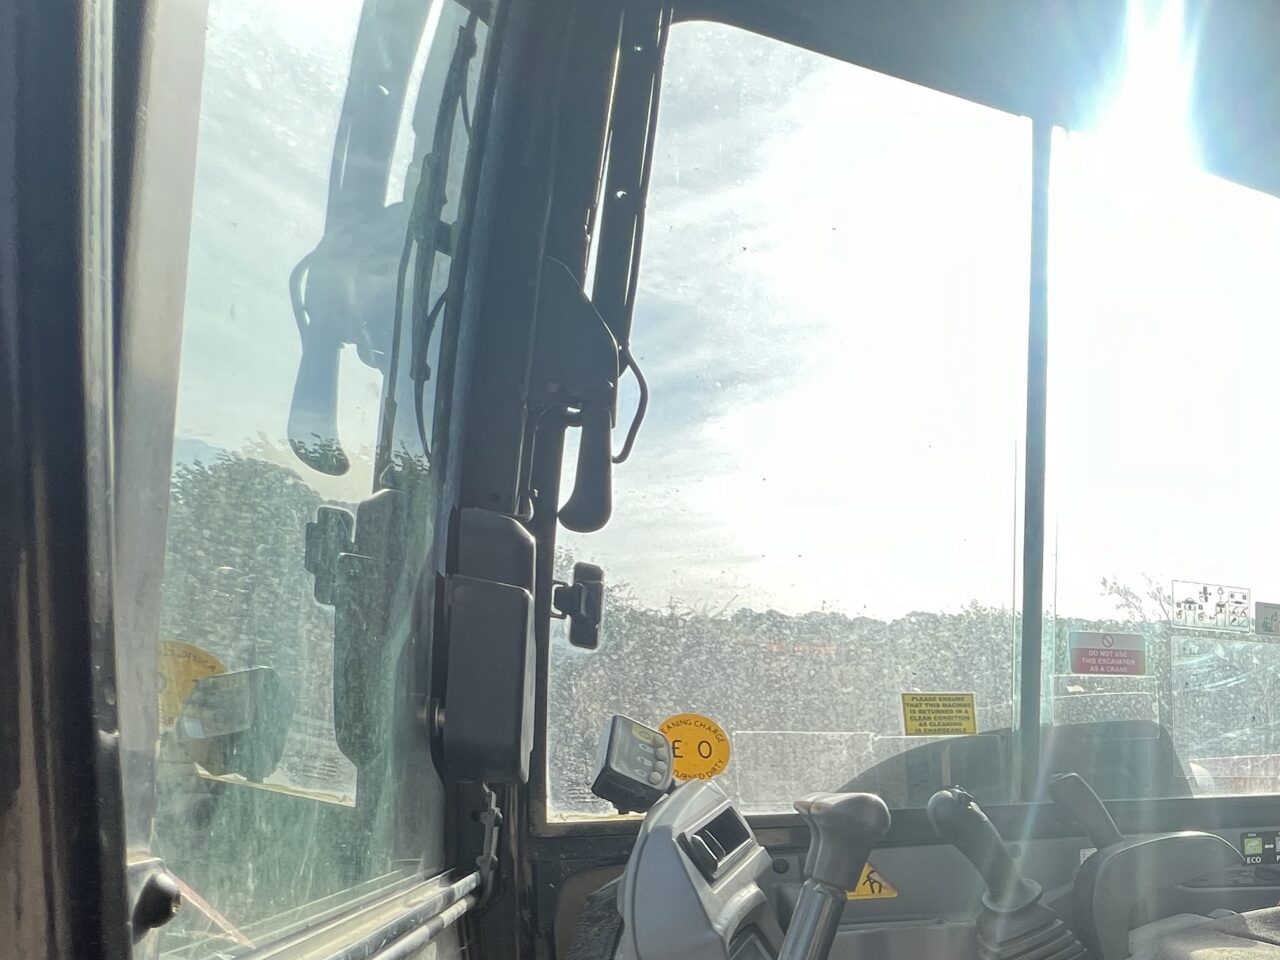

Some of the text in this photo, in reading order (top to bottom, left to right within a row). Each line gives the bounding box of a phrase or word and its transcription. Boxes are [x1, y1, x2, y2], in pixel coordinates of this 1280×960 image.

[1097, 657, 1136, 665] EXCAVATOR
[660, 719, 726, 743] EANING CHARGE
[1246, 856, 1262, 864] ECO
